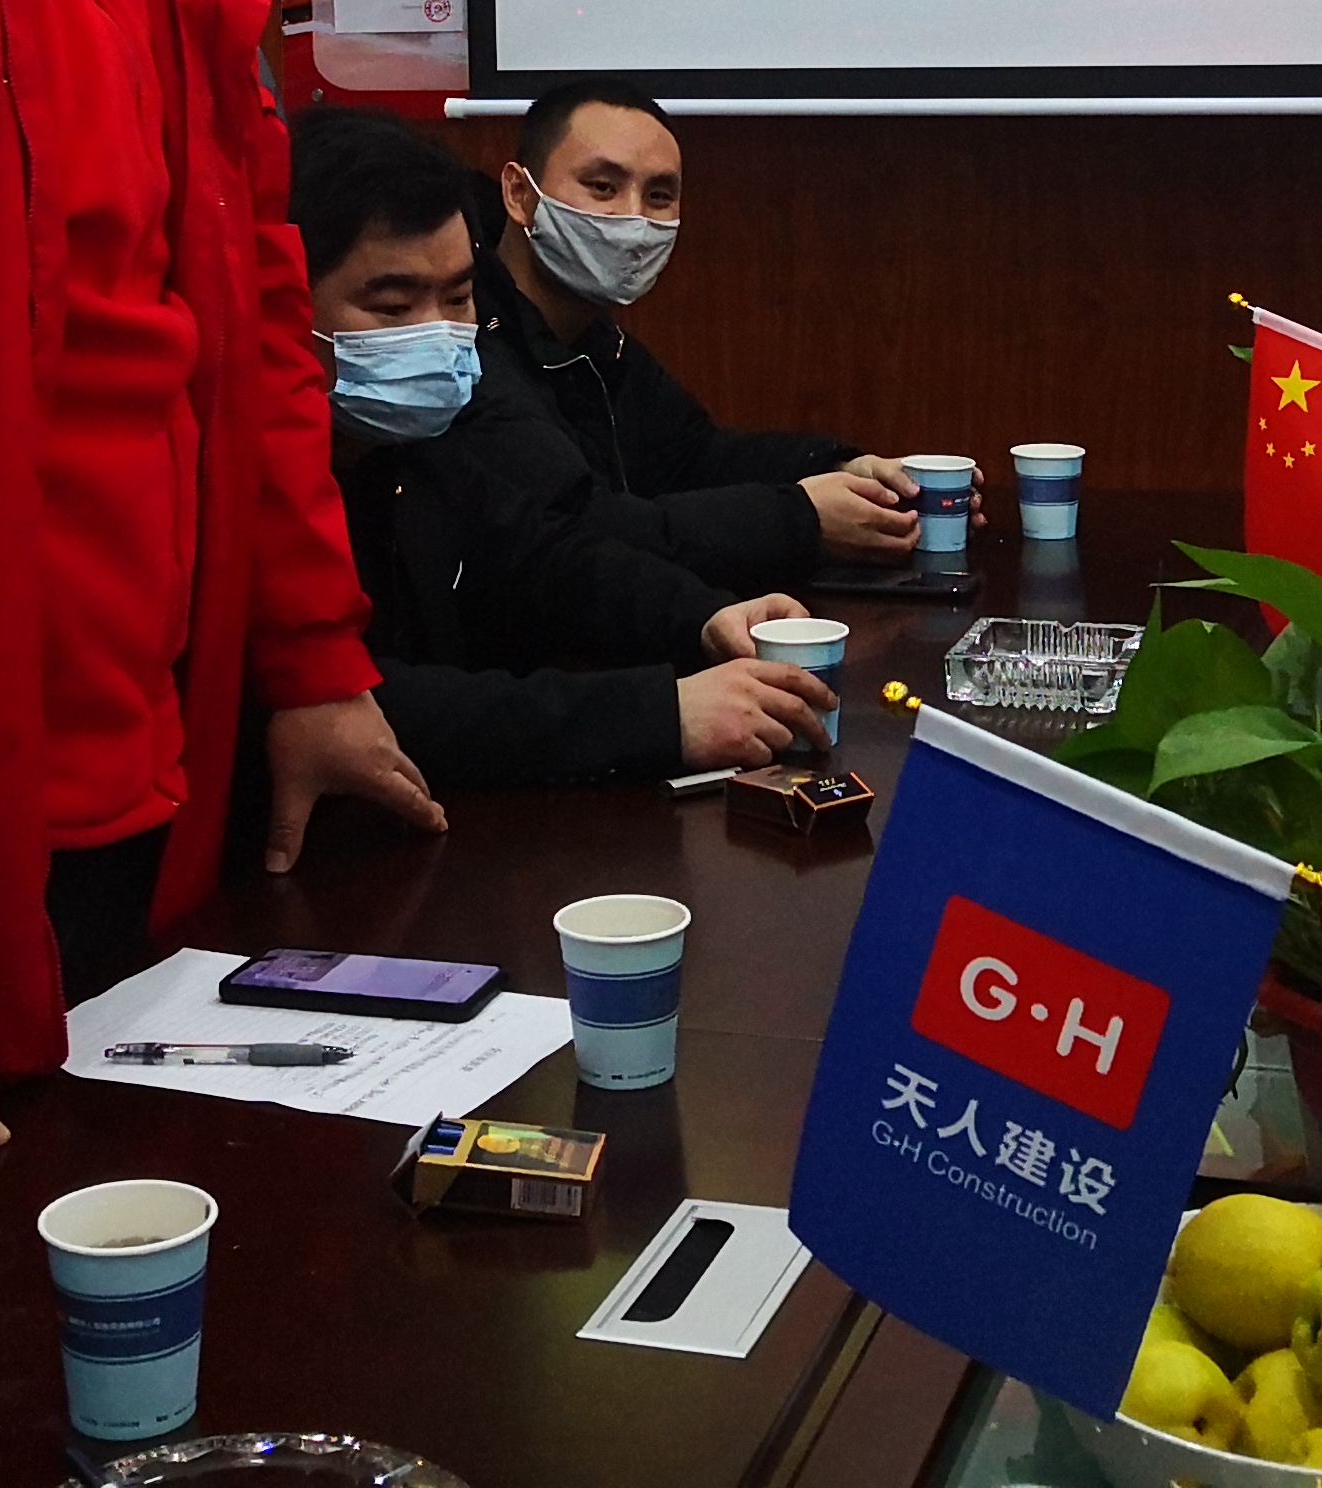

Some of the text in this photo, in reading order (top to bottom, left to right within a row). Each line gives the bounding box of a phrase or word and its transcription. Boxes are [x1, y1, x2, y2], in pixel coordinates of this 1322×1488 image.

[882, 1063, 1117, 1215] 天人建设
[928, 1151, 1098, 1250] Construction
